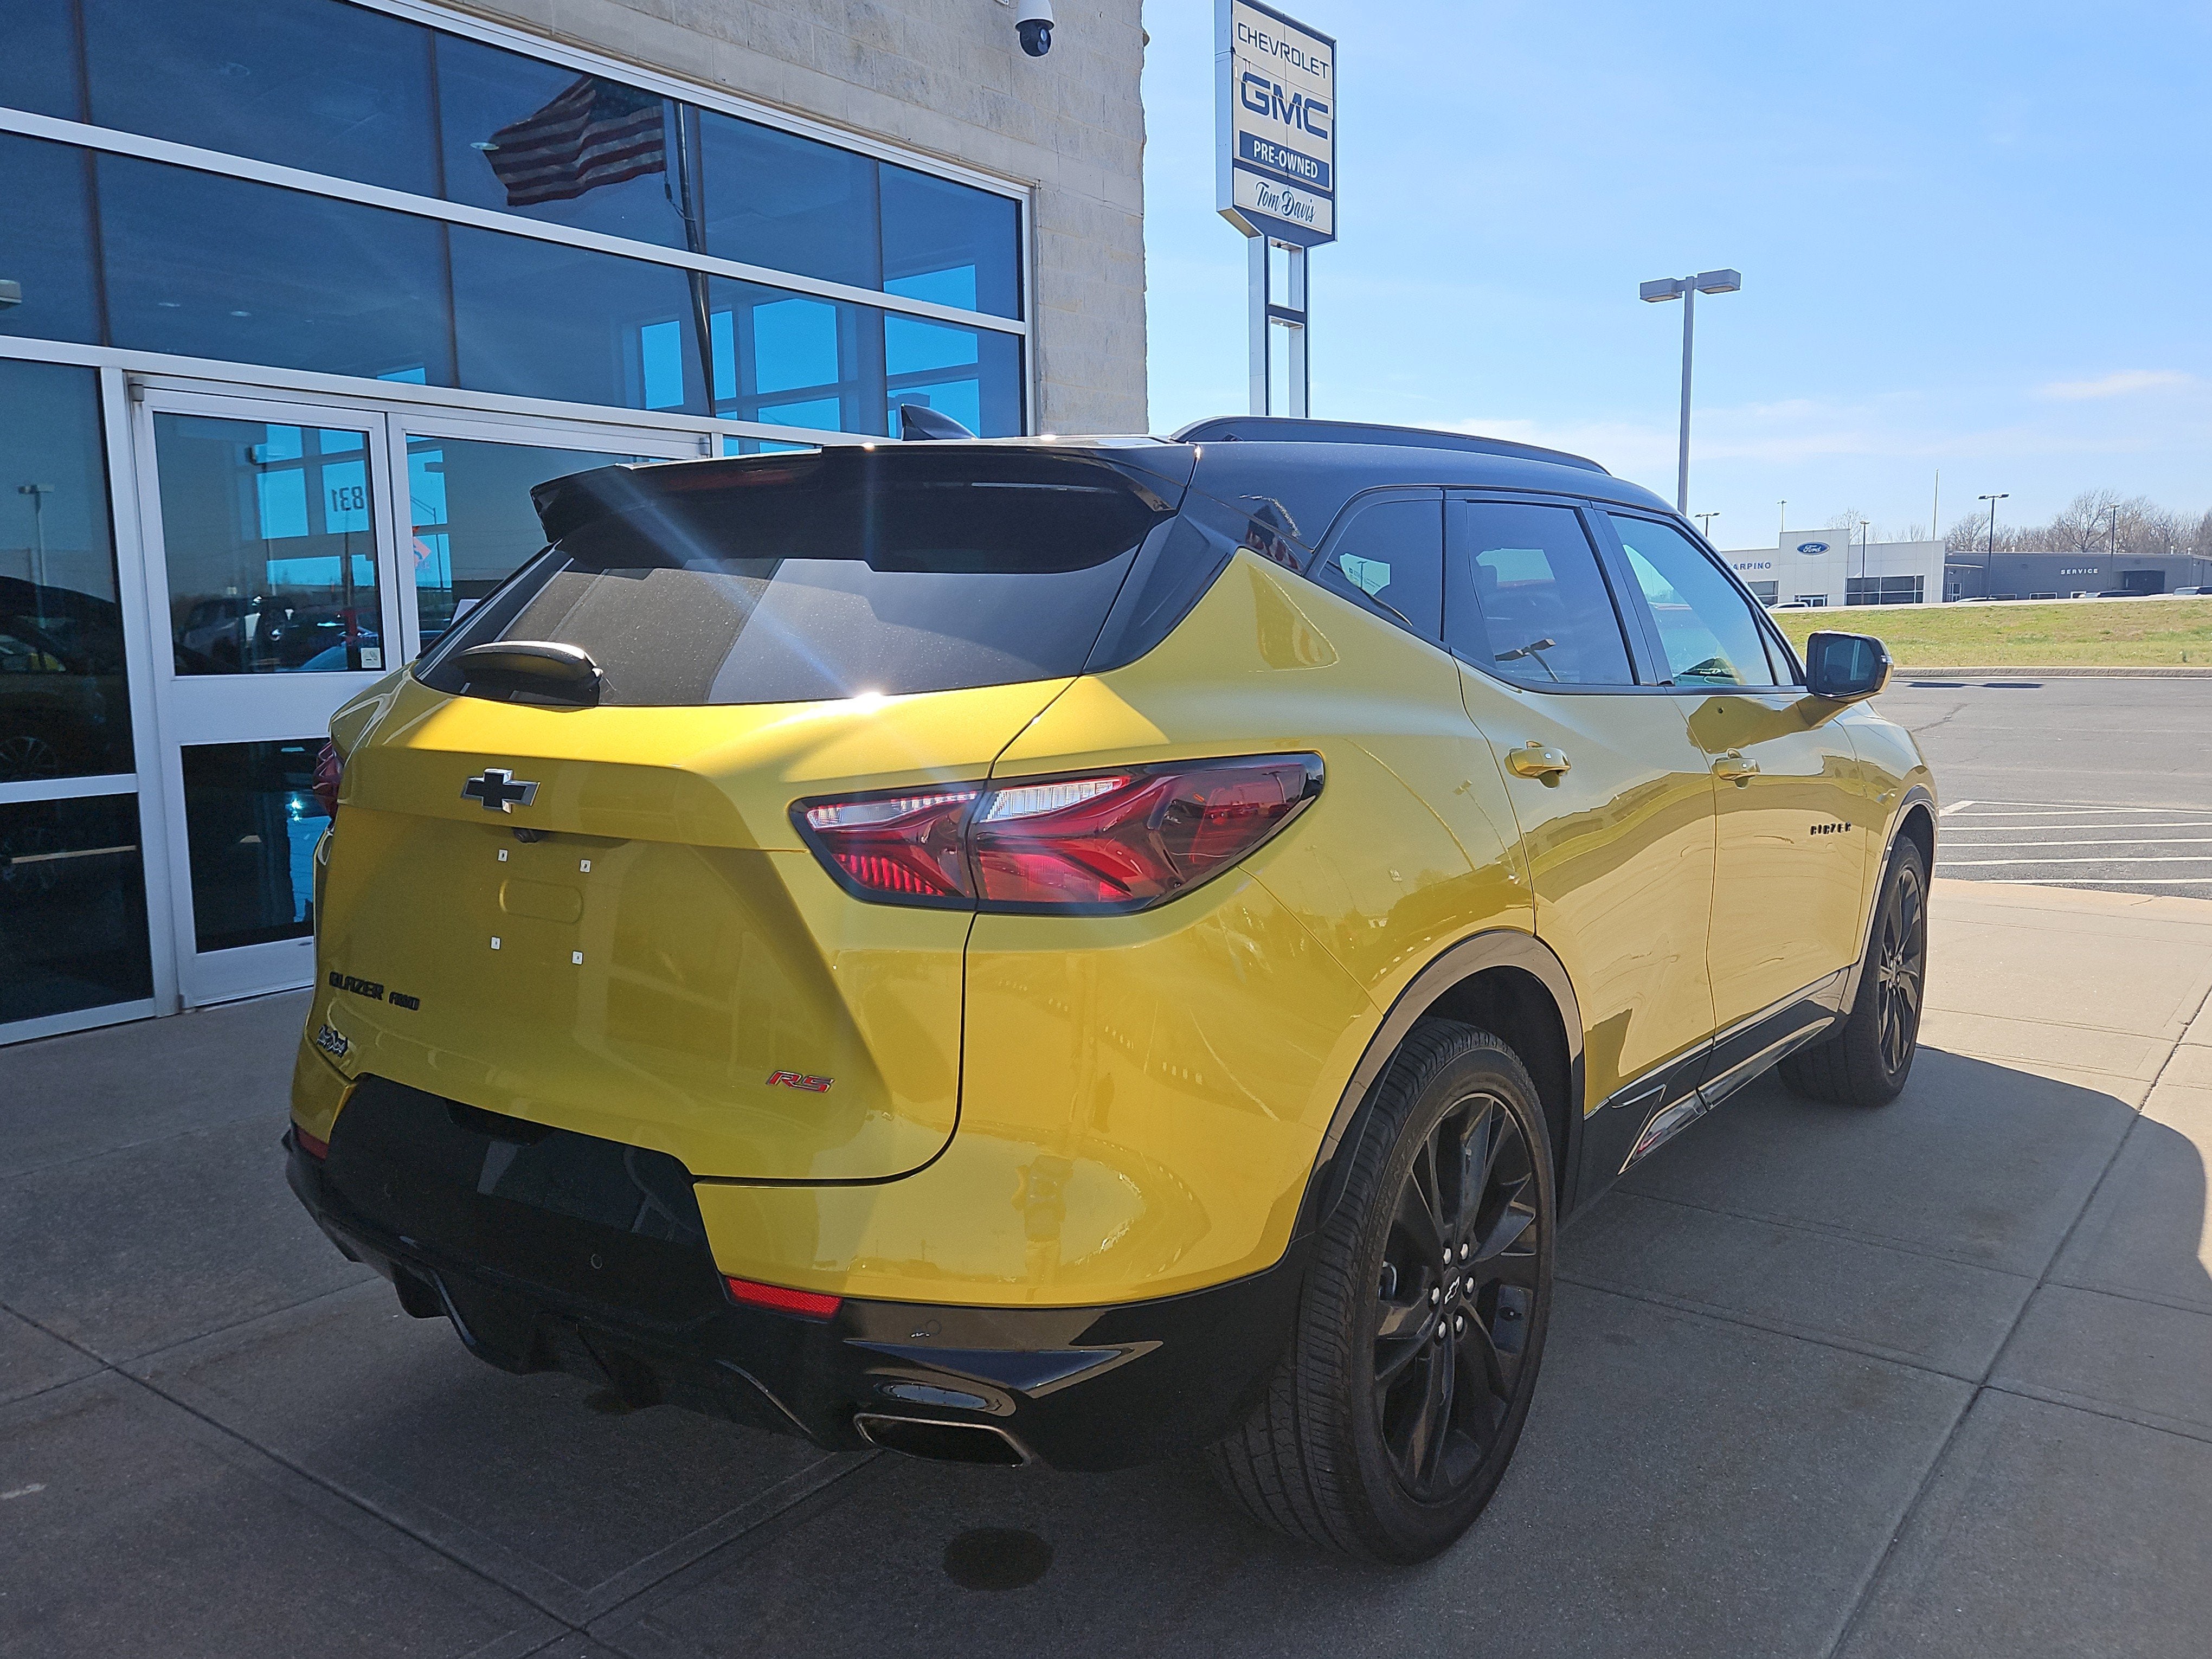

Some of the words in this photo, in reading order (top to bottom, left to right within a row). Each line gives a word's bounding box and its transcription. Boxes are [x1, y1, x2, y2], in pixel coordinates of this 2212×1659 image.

[1238, 22, 1329, 79] CHEVROLET
[1241, 71, 1328, 140] GMC
[1253, 139, 1318, 178] PRE-OWNED
[1255, 181, 1280, 211] Tom
[1282, 190, 1316, 222] Davis
[1803, 545, 1821, 553] Ford
[329, 971, 384, 1001] BLAZER
[766, 1070, 835, 1093] RS
